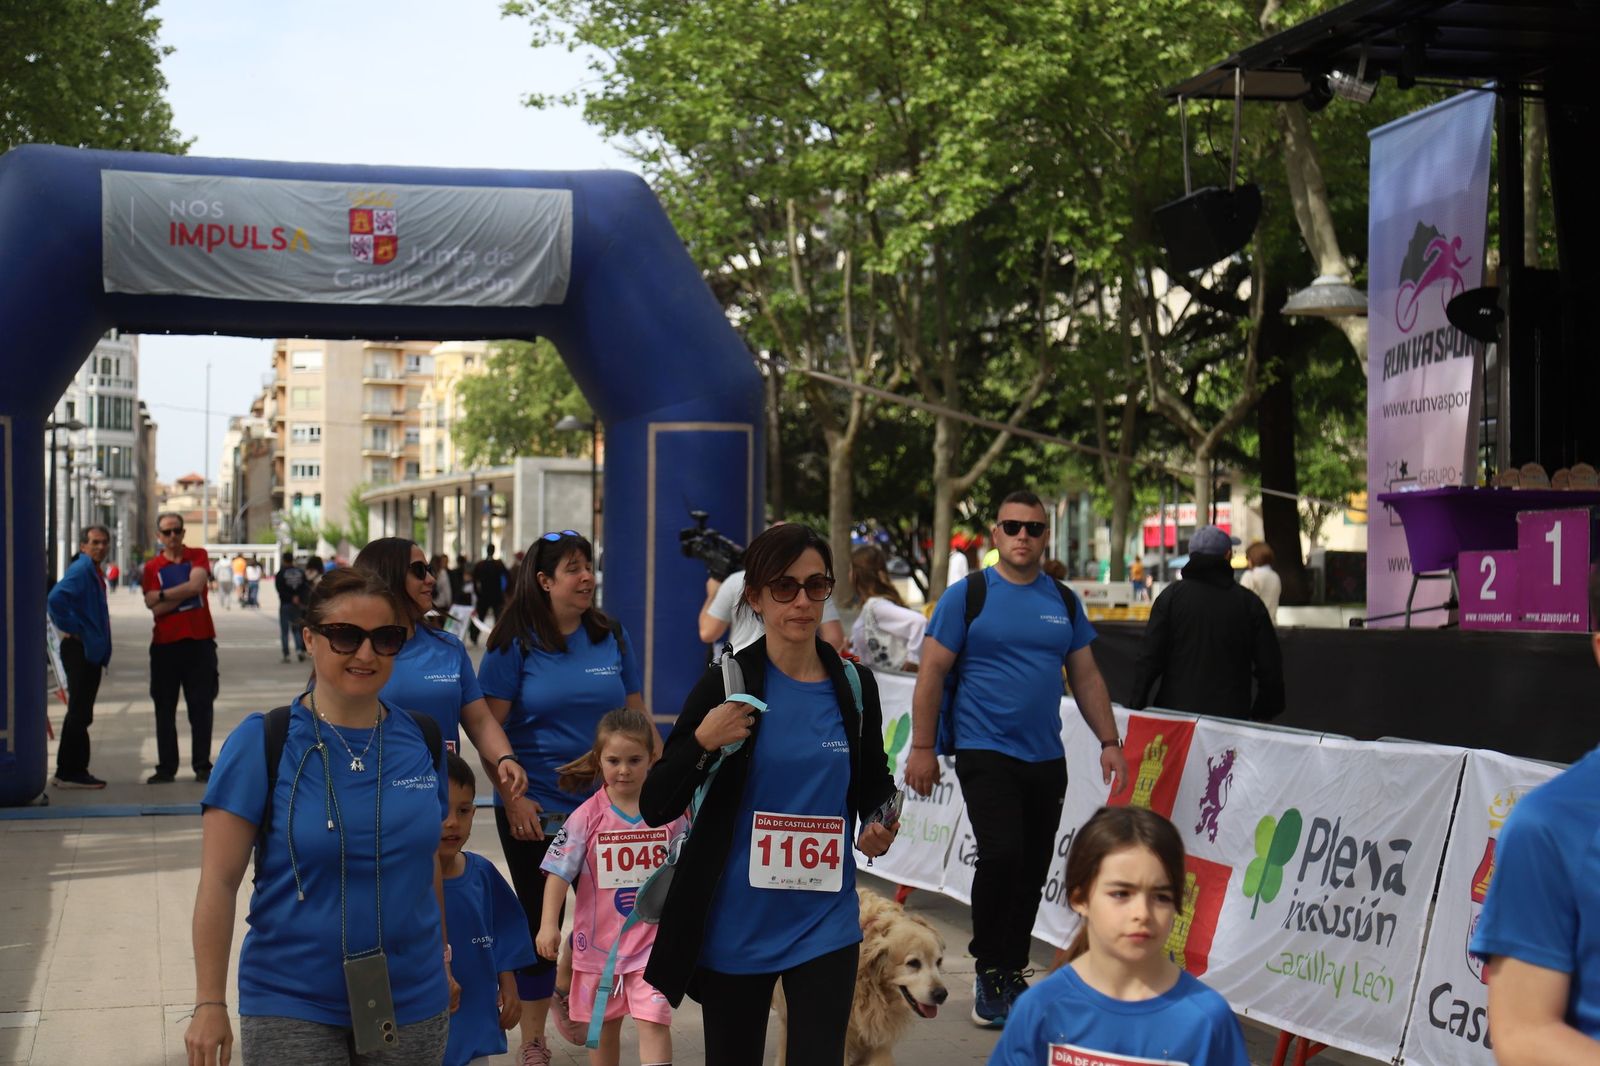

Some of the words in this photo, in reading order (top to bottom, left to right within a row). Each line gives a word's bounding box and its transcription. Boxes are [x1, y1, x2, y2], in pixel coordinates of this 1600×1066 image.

[169, 200, 224, 219] NOS
[169, 221, 313, 254] IMPULSA
[405, 245, 476, 266] Junta
[484, 246, 515, 266] de
[332, 268, 424, 290] Castilla
[453, 271, 515, 292] León
[1419, 466, 1457, 485] GRUPO
[1545, 520, 1562, 586] 1
[1480, 555, 1497, 601] 2
[757, 817, 772, 827] DÍA
[772, 819, 783, 827] DE
[784, 820, 816, 829] CASTILLA
[822, 822, 840, 830] LEÓN
[619, 833, 646, 841] CASTILLA
[650, 831, 665, 839] LEÓN
[601, 844, 667, 872] 1048
[757, 834, 840, 870] 1164
[1297, 816, 1413, 897] Plena
[1055, 1051, 1073, 1065] DÍA
